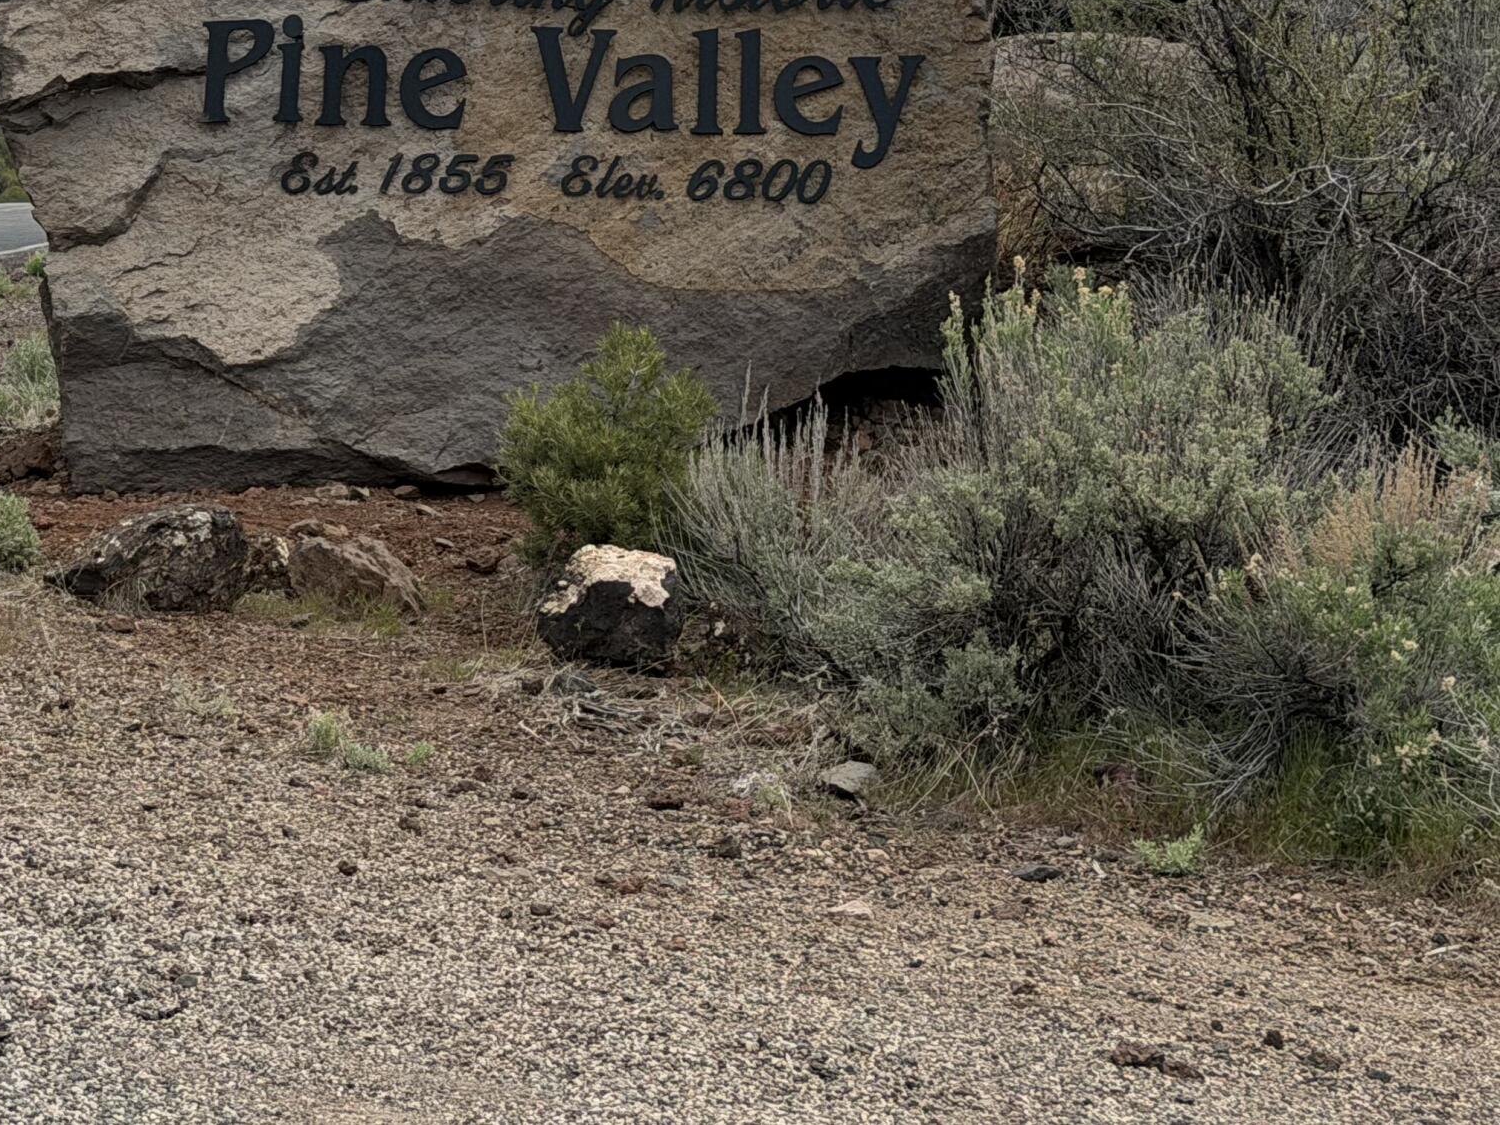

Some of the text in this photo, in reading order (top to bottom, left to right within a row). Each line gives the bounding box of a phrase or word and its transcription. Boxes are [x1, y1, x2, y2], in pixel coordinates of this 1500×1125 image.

[199, 13, 926, 170] Pine Valley
[280, 151, 833, 205] Est. 1855 Elev. 6800
